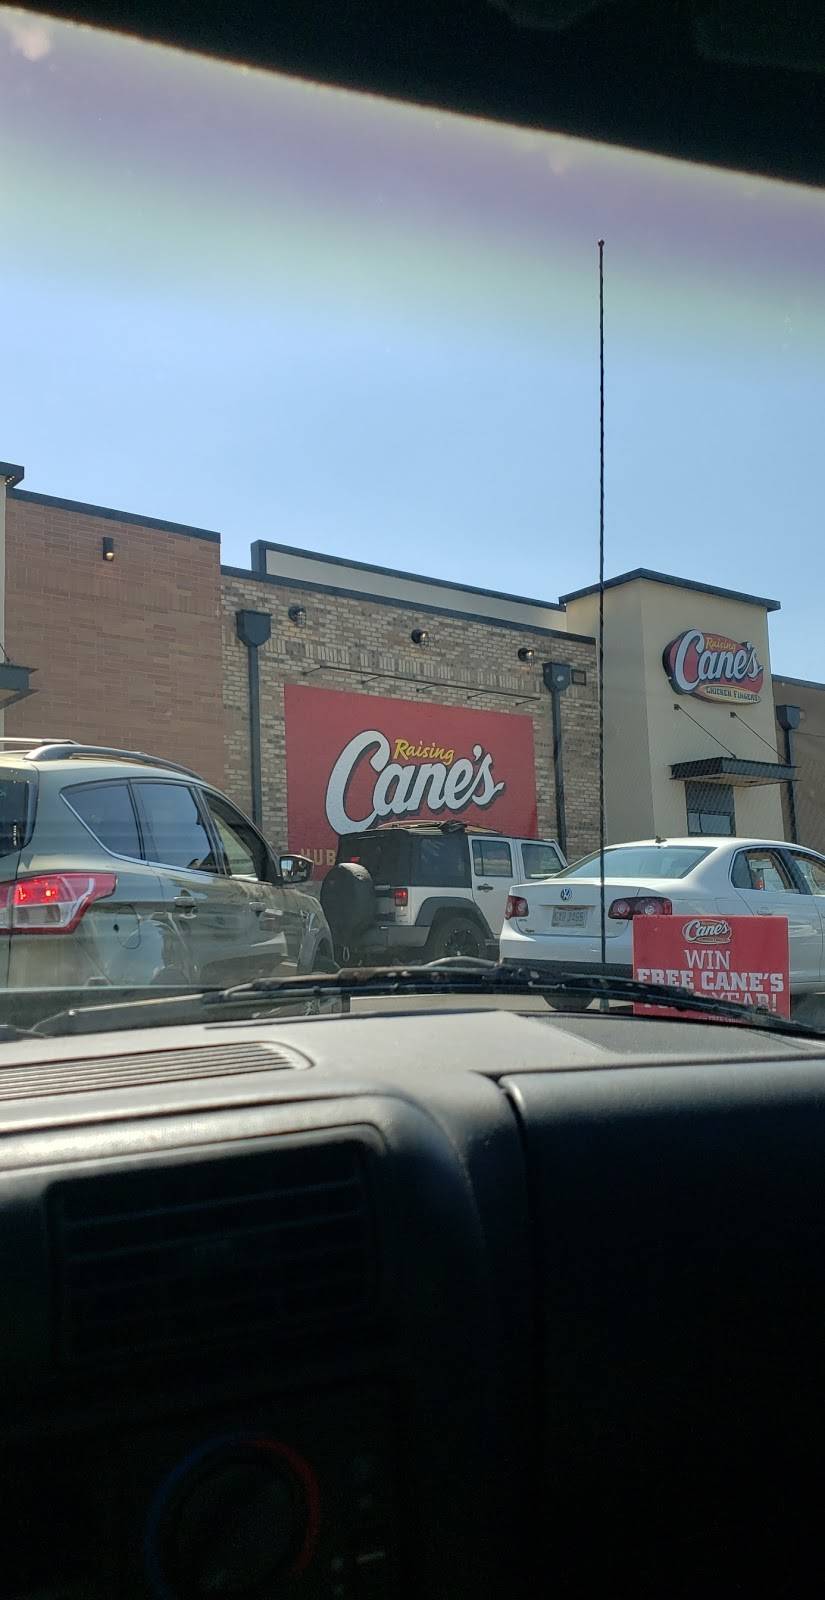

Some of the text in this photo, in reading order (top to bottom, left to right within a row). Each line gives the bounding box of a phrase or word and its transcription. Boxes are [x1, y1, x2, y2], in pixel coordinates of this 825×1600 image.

[705, 637, 737, 652] Raising
[675, 628, 764, 691] Cane's
[706, 687, 759, 702] CHICKEN FINGERS
[393, 738, 456, 766] Raising
[325, 729, 505, 836] Cane's
[684, 919, 730, 941] Cane's
[684, 949, 731, 970] WIN
[636, 968, 784, 993] FREE CANE'S
